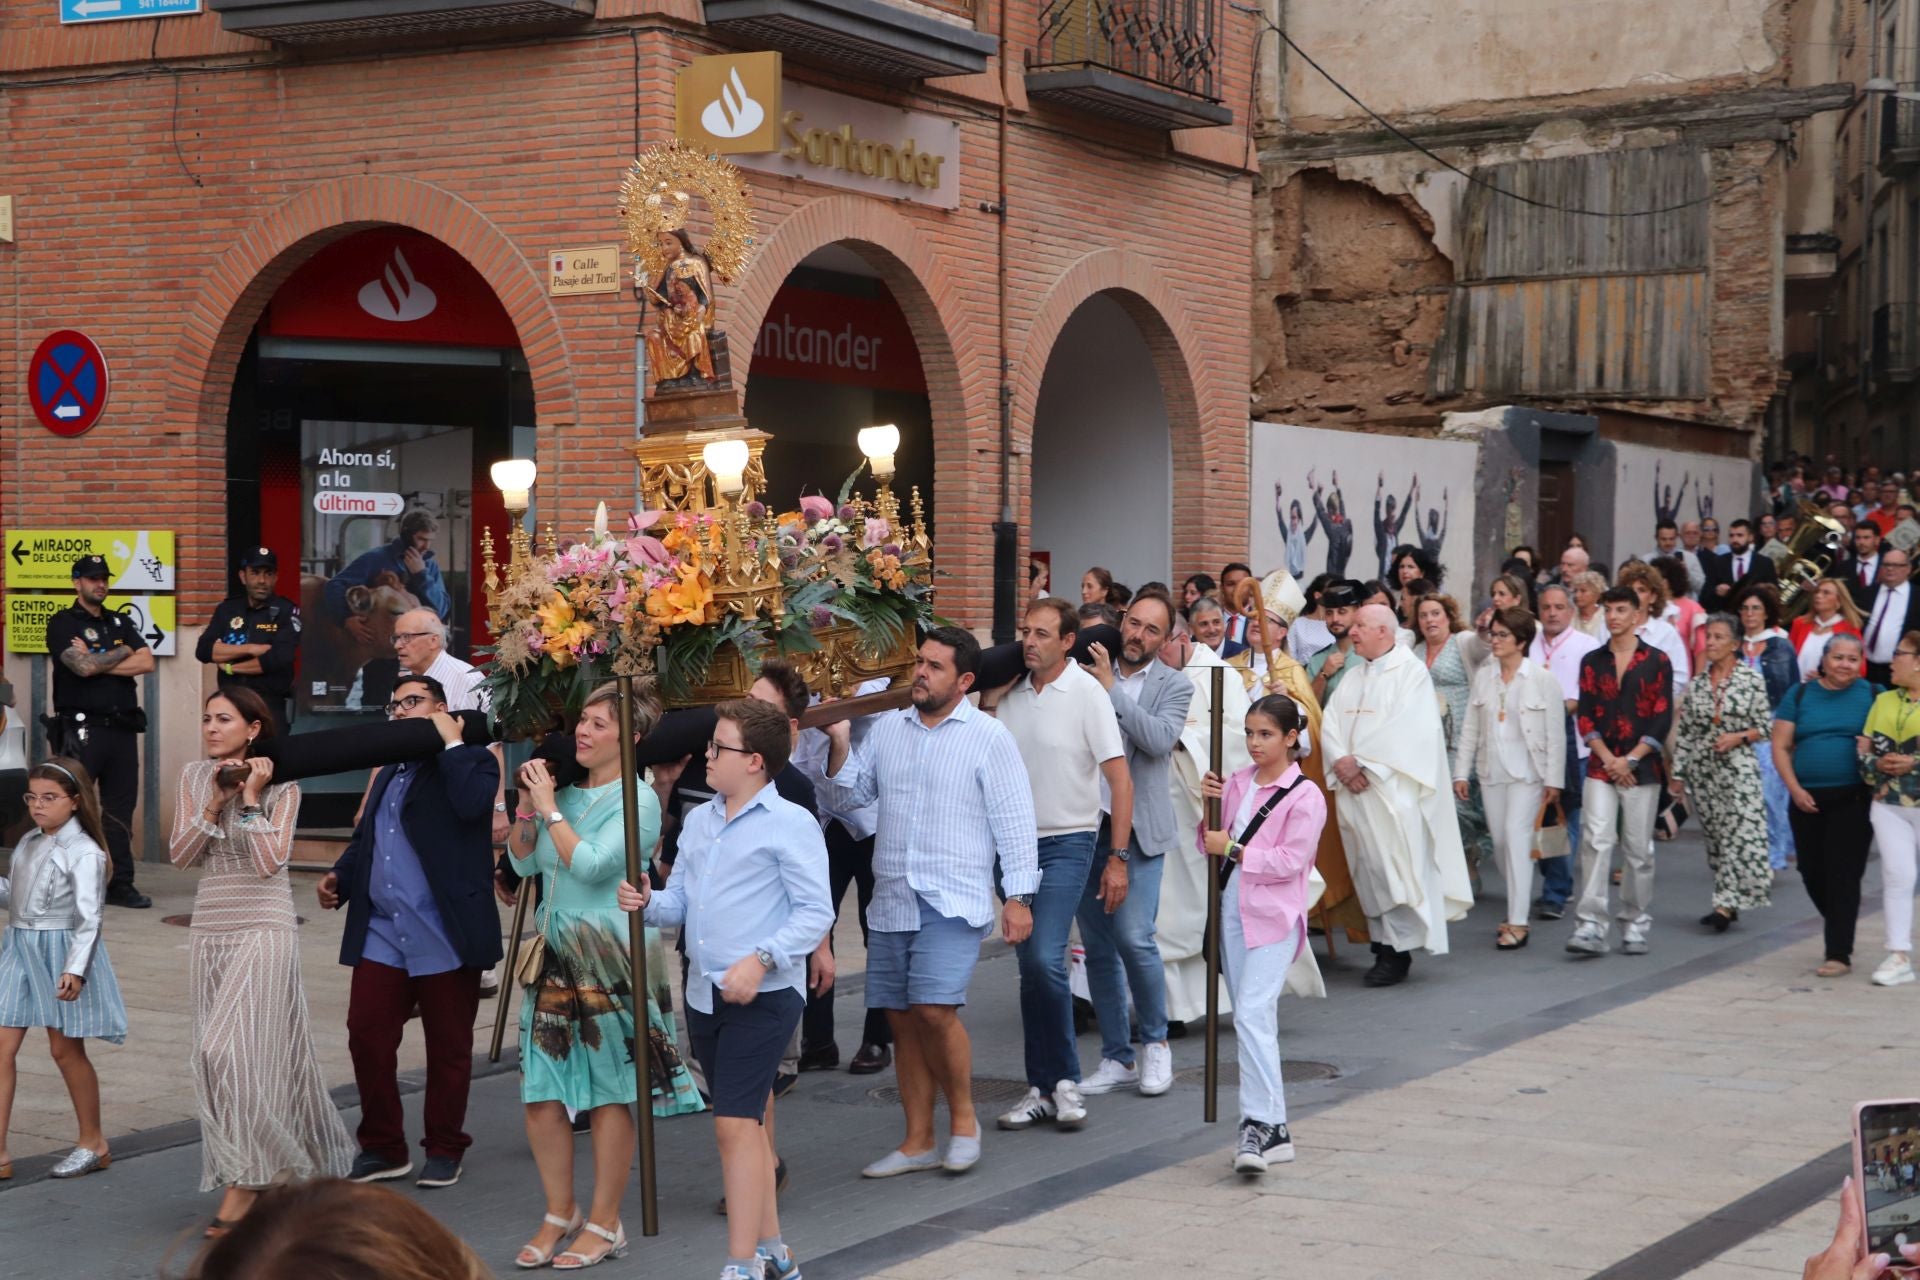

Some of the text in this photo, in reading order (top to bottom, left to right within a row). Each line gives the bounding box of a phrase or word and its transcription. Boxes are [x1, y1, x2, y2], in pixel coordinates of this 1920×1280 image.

[781, 110, 944, 189] Santander
[572, 258, 599, 270] Calle
[553, 272, 616, 288] Pasaje del Toril
[318, 448, 396, 470] Ahora sí,
[319, 470, 351, 487] a la
[319, 493, 376, 512] última
[33, 539, 93, 552] MIRADOR
[33, 553, 44, 563] DE
[46, 553, 61, 563] LAS
[12, 600, 55, 612] CENTRO
[12, 626, 46, 634] DE LOS SOT
